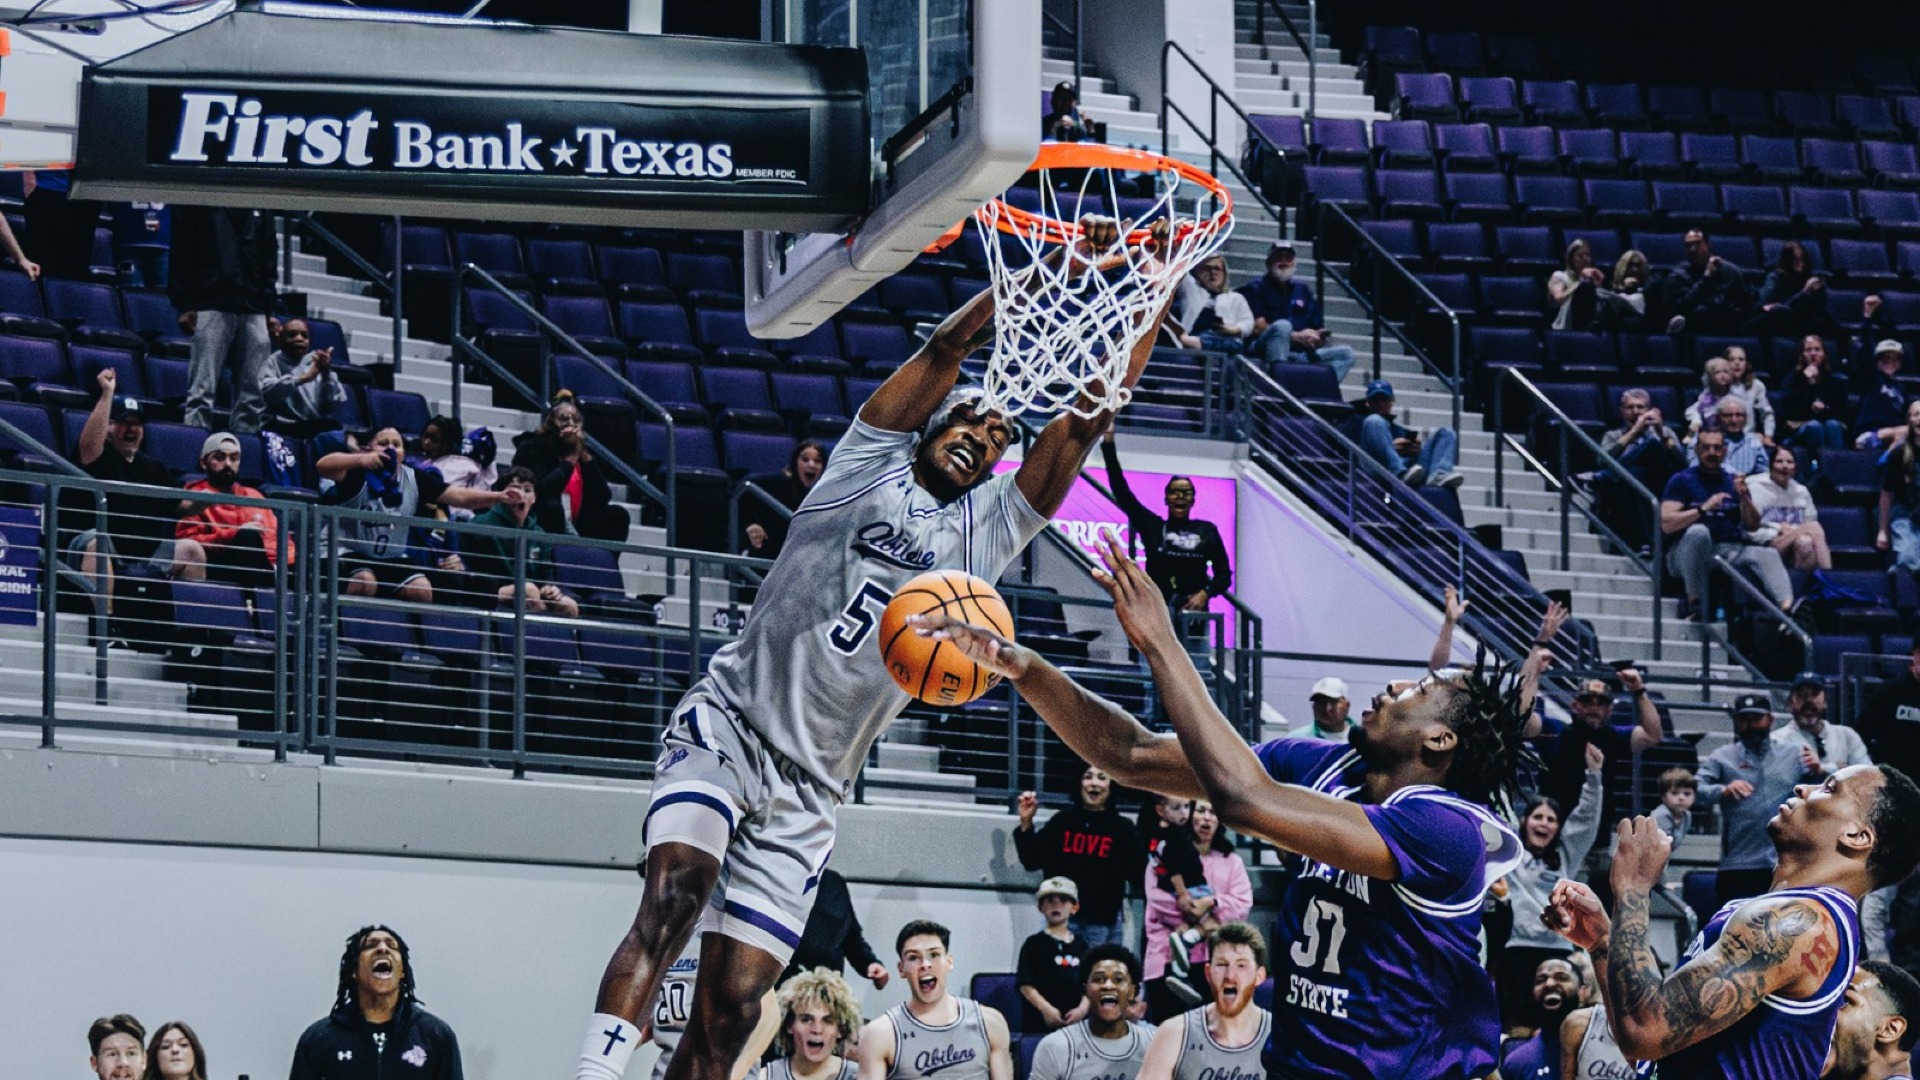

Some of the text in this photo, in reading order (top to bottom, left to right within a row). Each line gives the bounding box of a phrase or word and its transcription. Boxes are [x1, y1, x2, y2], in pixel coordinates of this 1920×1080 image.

[170, 92, 733, 178] First Bank Texas
[735, 168, 796, 179] MEMBER FDIC
[826, 577, 894, 656] 5
[1062, 831, 1113, 858] LOVE
[1285, 973, 1350, 1019] STATE
[915, 1043, 977, 1073] Abilene
